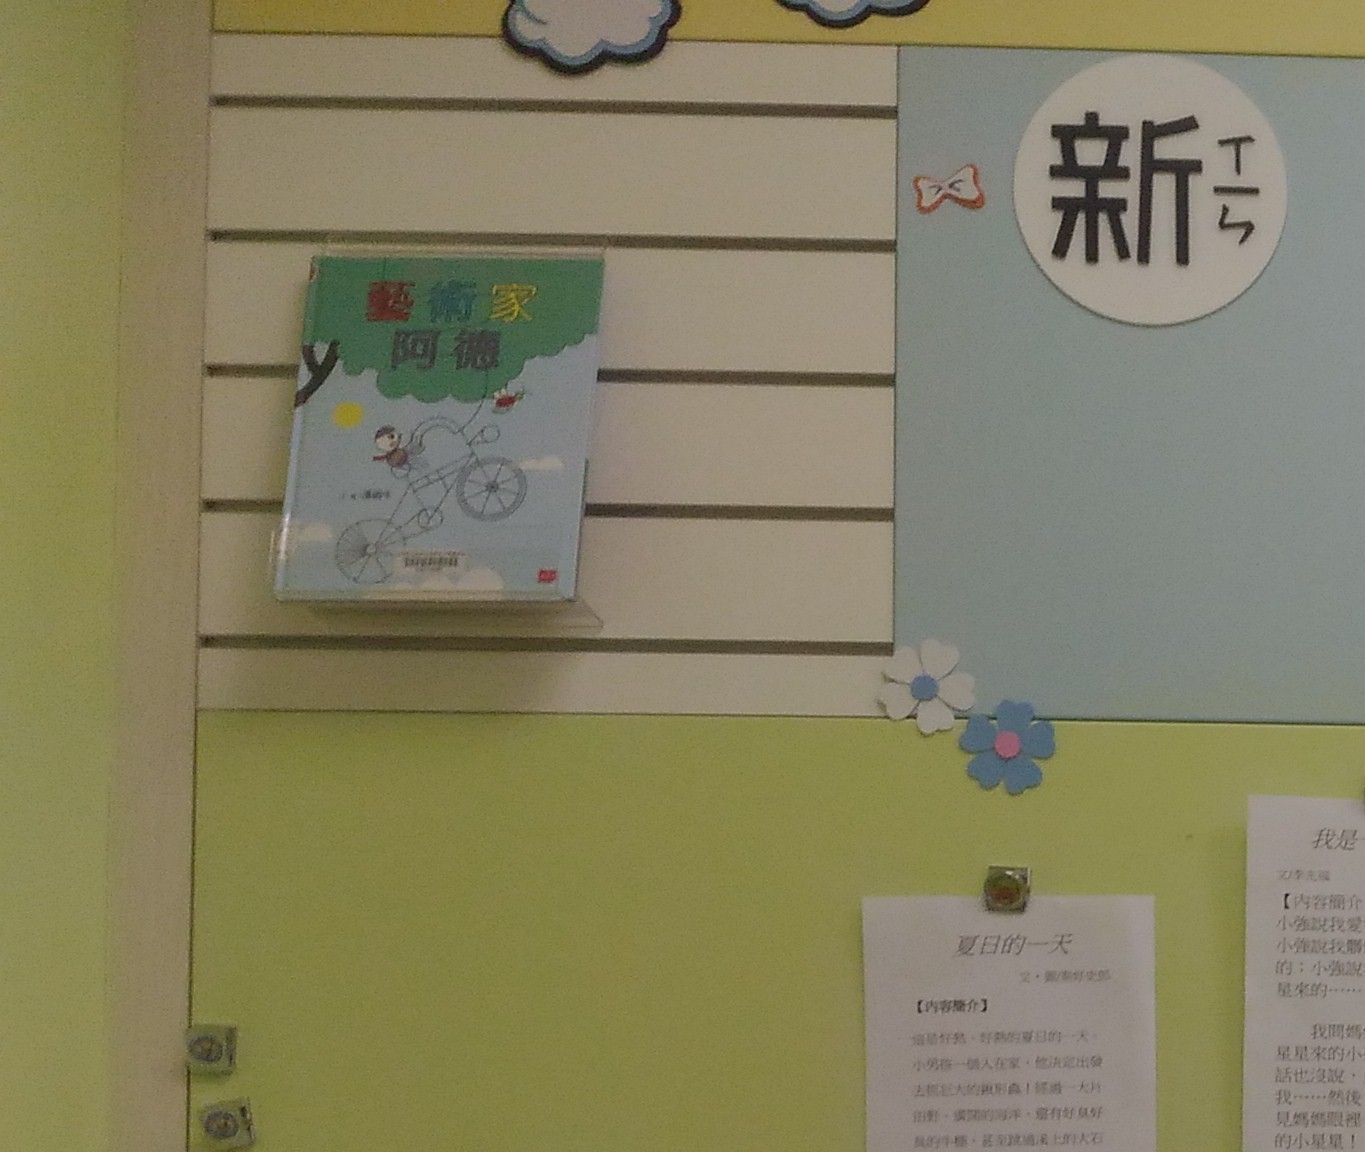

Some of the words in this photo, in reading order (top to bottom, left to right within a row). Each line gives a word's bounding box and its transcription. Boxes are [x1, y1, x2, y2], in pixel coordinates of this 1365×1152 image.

[365, 281, 540, 324] 藝術家
[390, 329, 502, 373] 阿德
[956, 933, 1073, 956] 夏日的一天
